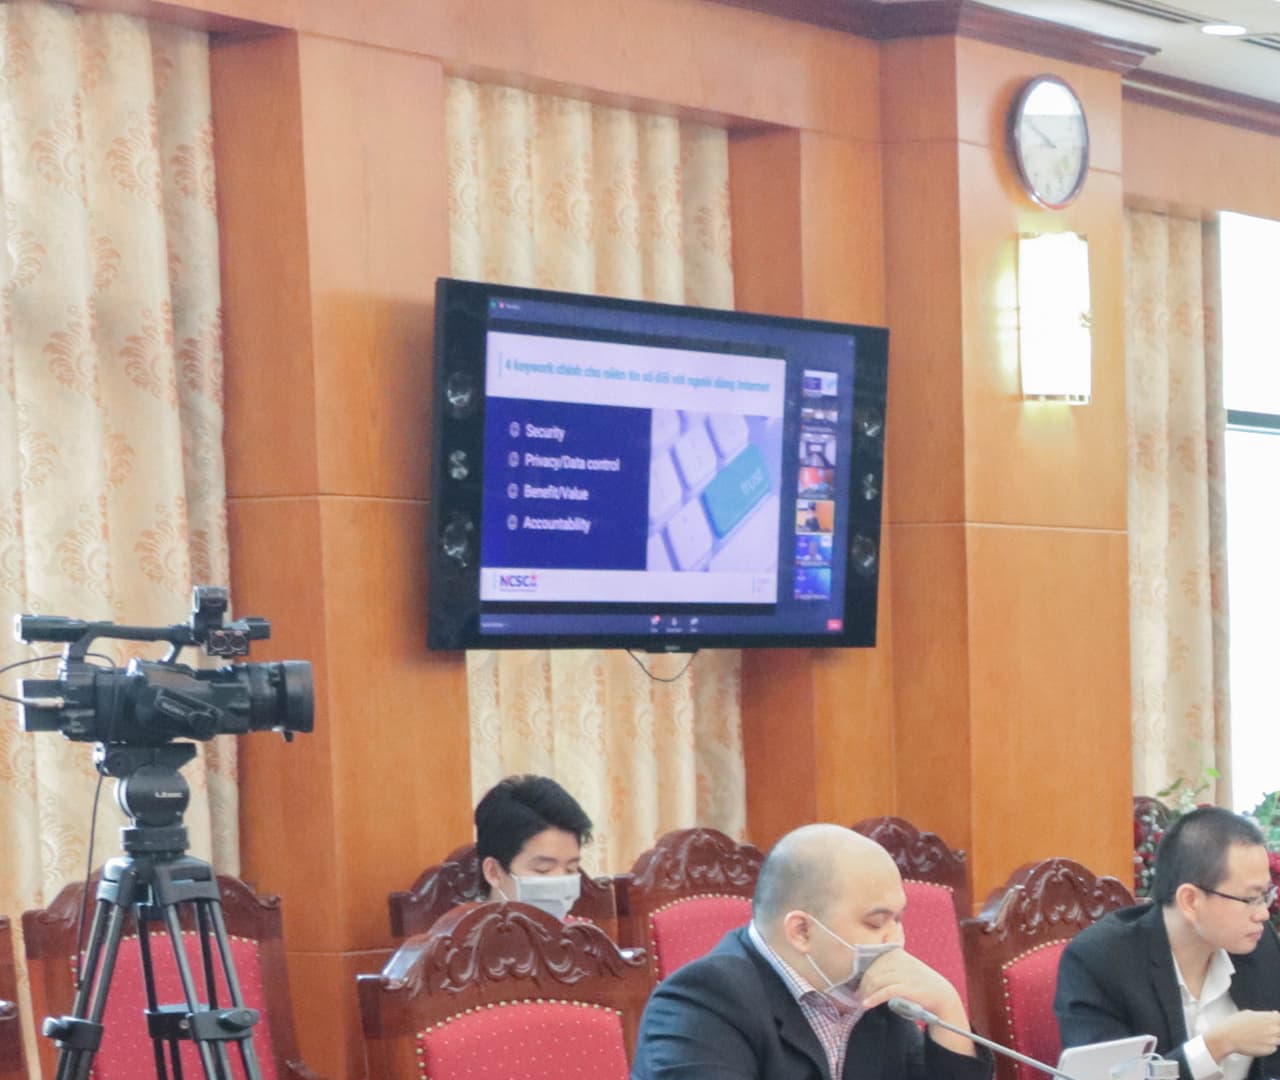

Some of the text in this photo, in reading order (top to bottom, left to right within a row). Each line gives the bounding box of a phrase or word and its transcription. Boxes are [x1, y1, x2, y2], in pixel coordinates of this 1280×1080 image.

[526, 422, 566, 442] Security
[524, 452, 620, 471] Privacy/Data control
[524, 483, 590, 501] Benefit/Value
[523, 515, 592, 535] Accountability
[500, 575, 530, 587] NCSC
